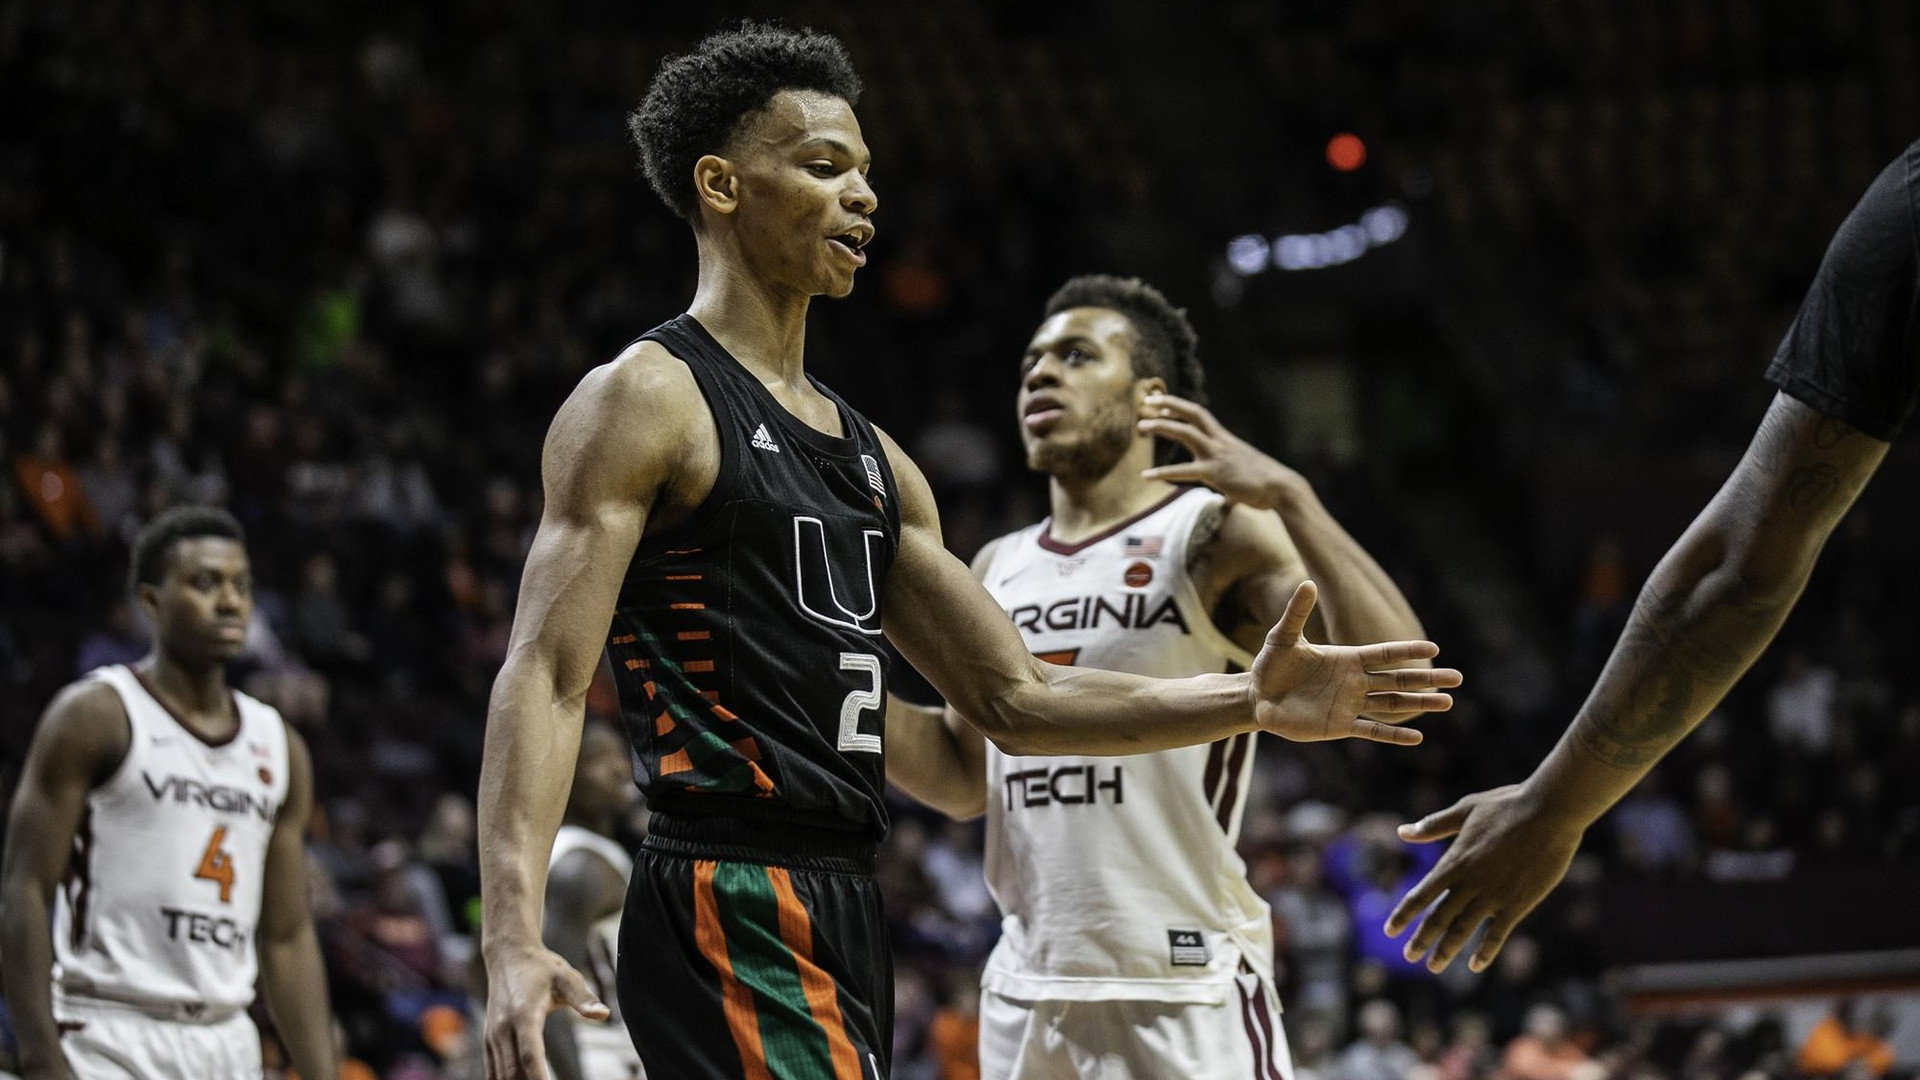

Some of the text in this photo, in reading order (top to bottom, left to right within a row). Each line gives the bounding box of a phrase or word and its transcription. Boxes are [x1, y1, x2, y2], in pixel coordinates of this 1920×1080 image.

[751, 439, 780, 453] adidas
[793, 516, 884, 634] U
[1006, 593, 1191, 635] RGINIA
[837, 652, 883, 754] 2
[1005, 765, 1122, 811] TECH
[194, 825, 235, 903] 4
